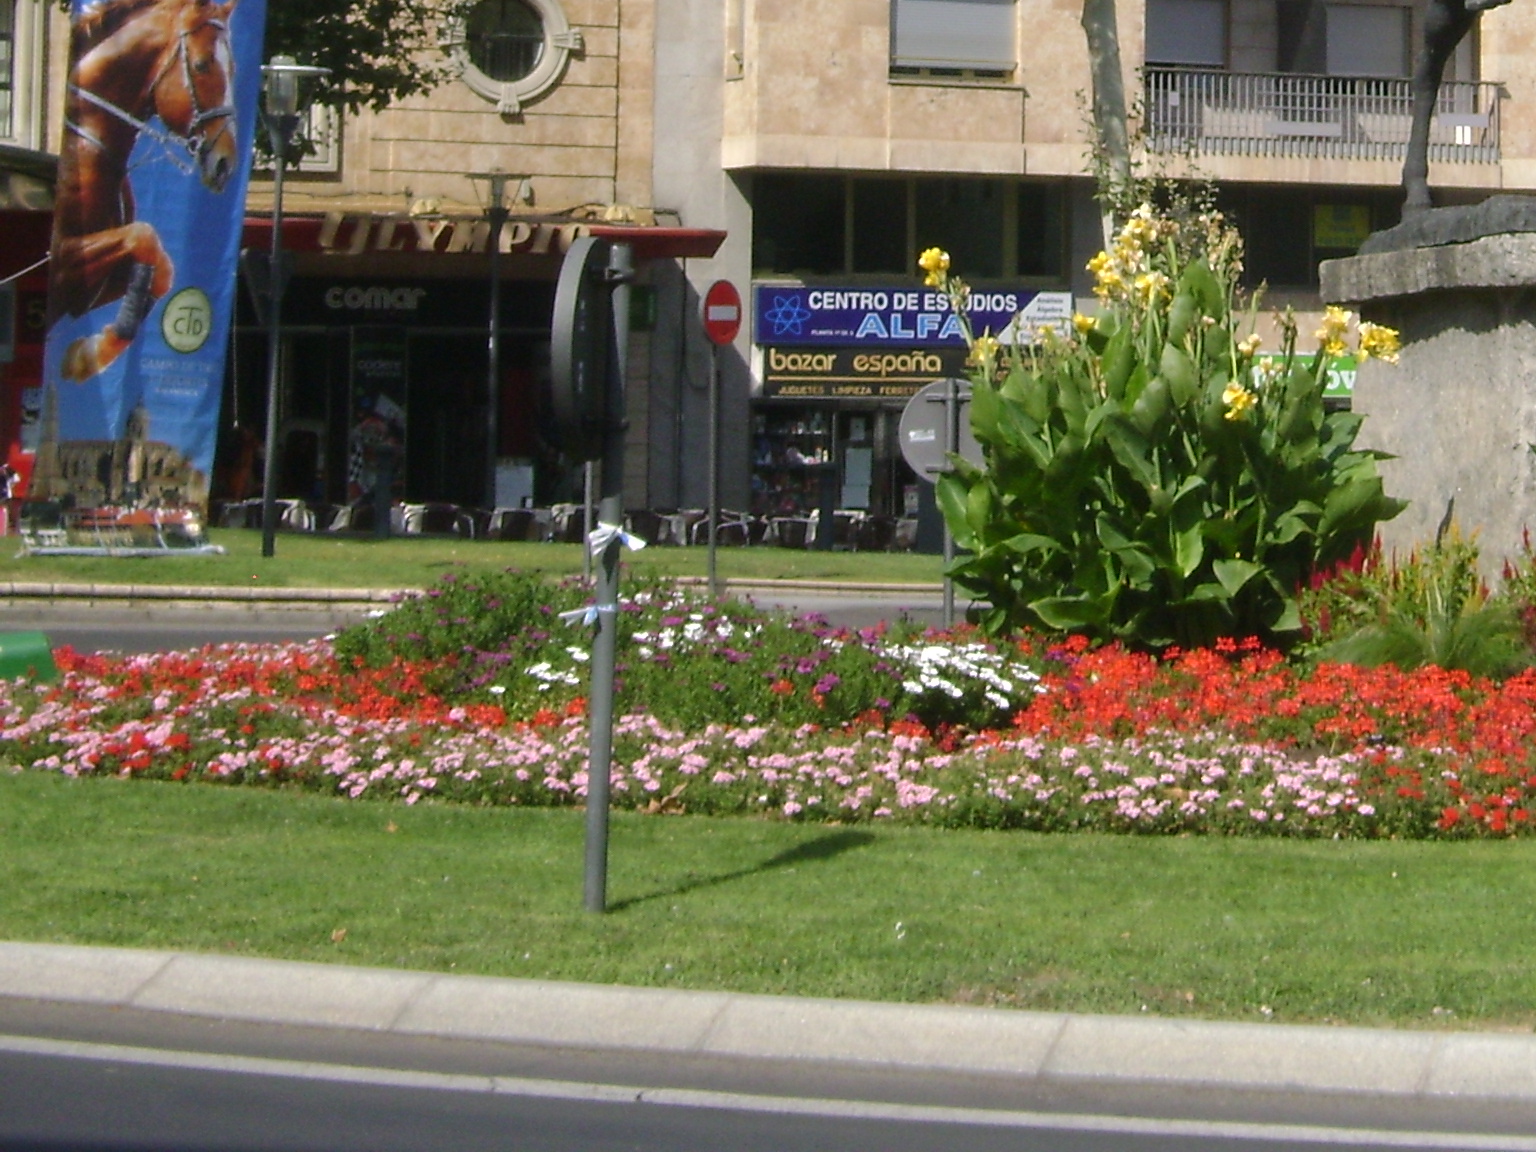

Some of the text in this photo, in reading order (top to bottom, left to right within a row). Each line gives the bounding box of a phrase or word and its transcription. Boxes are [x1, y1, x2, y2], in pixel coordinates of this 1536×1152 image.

[808, 291, 1018, 313] CENTRO DE ESUDIOS
[855, 312, 966, 339] ALFA
[769, 348, 837, 371] bazar
[853, 350, 942, 377] españa
